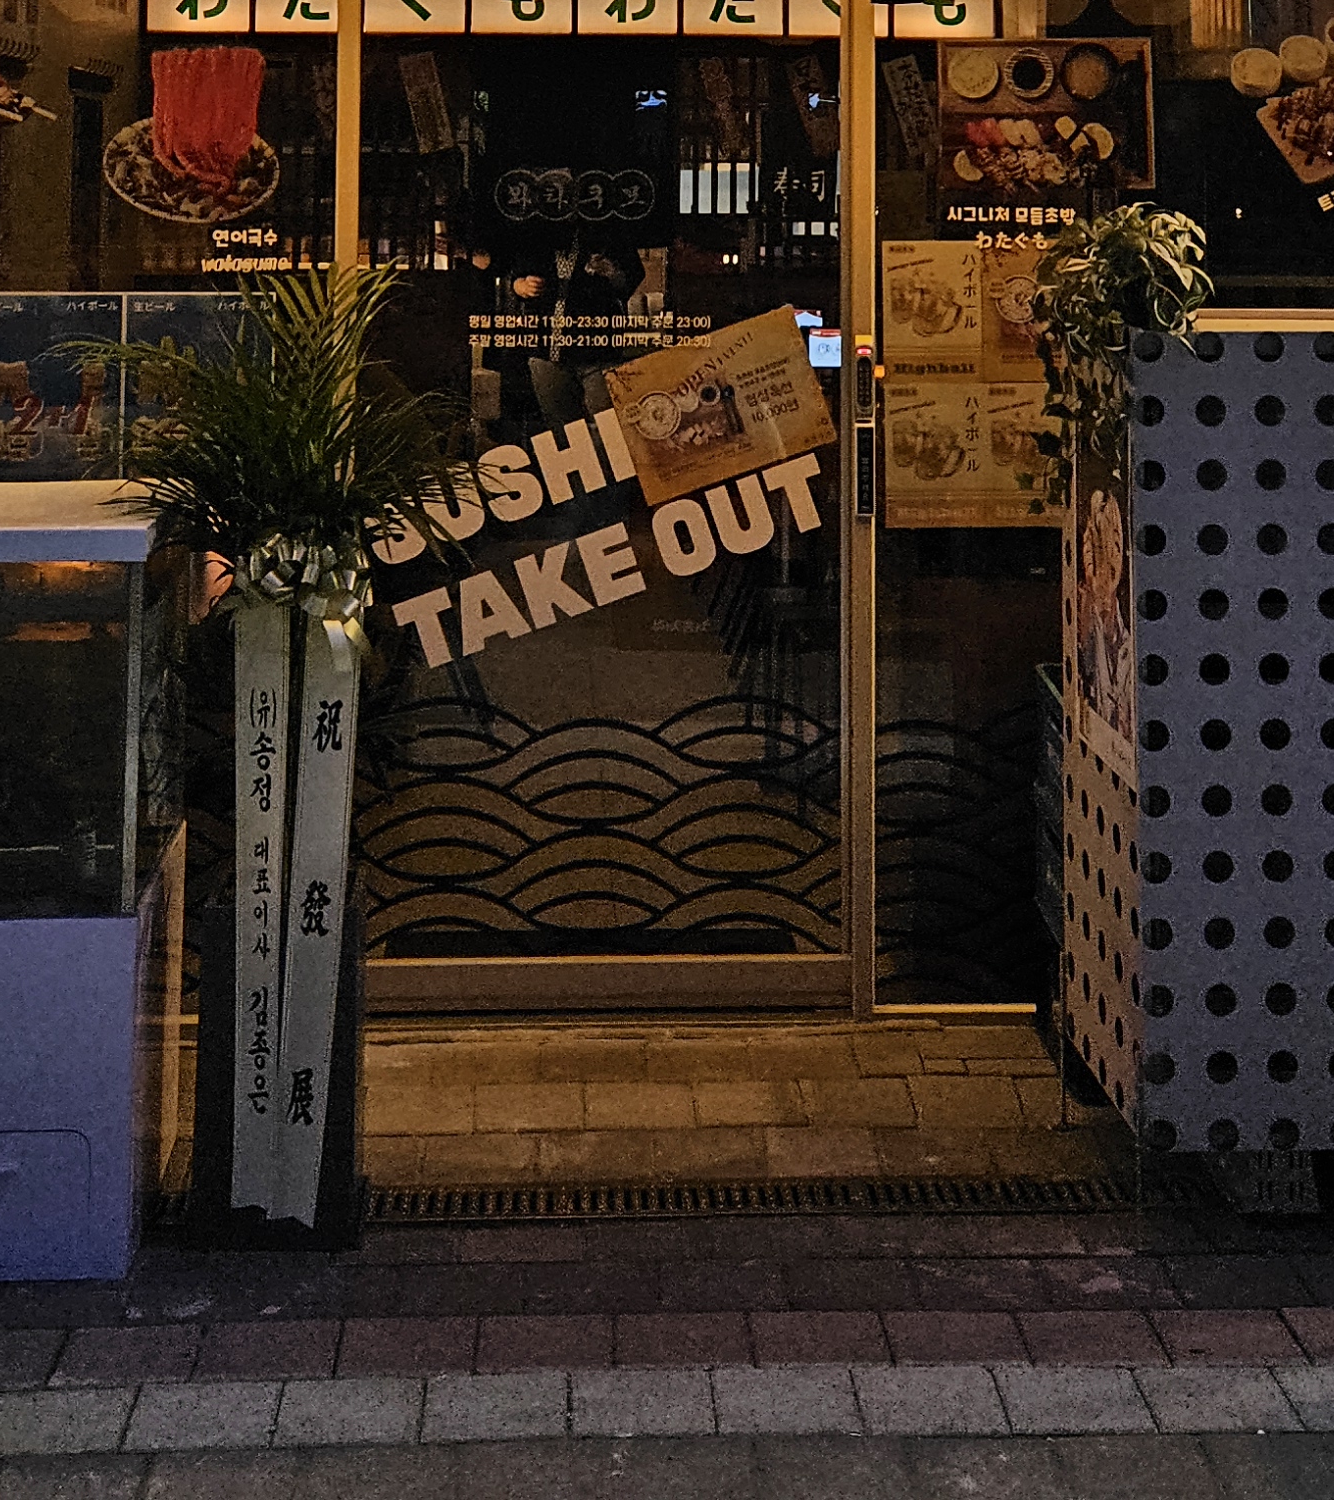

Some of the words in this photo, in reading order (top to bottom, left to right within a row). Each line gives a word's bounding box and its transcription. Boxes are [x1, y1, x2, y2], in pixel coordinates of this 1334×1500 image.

[946, 205, 1011, 223] 시그니처
[1014, 205, 1077, 227] 모듬초밥
[211, 228, 279, 248] 연어국수
[974, 230, 1049, 251] わたぐも
[961, 253, 978, 330] ハイボール
[468, 314, 491, 329] 평일
[494, 314, 540, 329] 영업시간
[468, 333, 492, 348] 주말
[494, 333, 540, 348] 영업시간
[964, 395, 980, 473] ハイボール
[363, 408, 638, 565] SUSHI
[391, 522, 647, 669] TAKE
[651, 453, 822, 577] OUT
